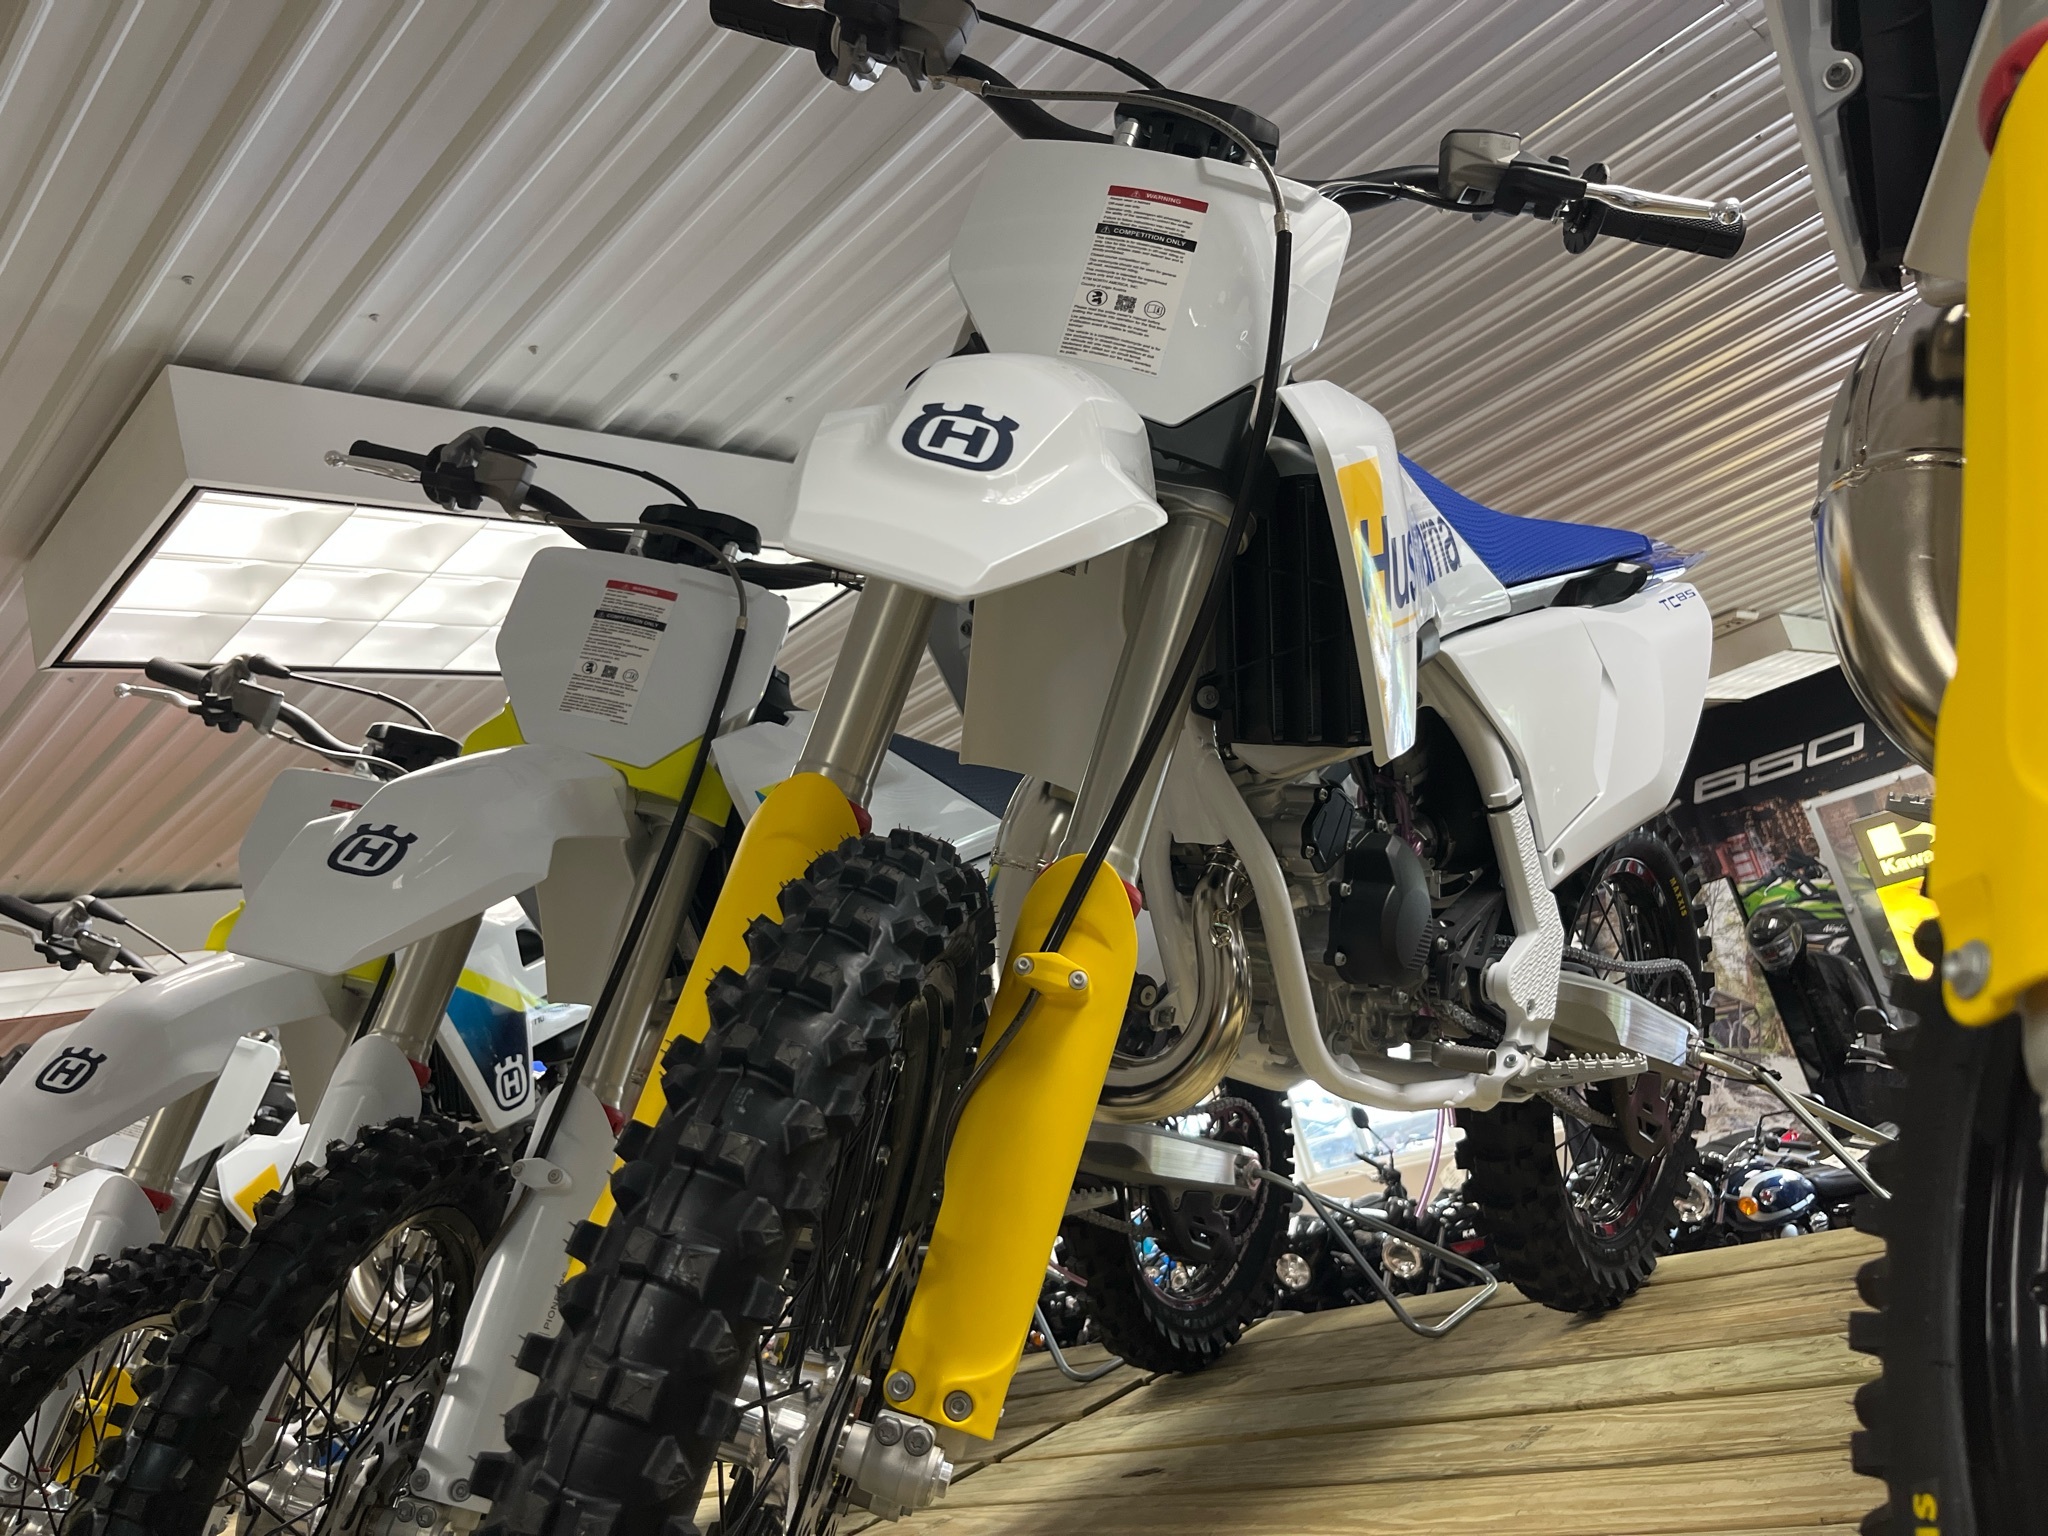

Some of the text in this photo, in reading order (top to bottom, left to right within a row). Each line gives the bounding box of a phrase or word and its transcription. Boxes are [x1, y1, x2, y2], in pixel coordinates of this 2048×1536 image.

[1146, 192, 1182, 205] WARNING
[1114, 228, 1186, 247] COMPETITION ONLY
[1658, 589, 1696, 610] TC85
[606, 614, 660, 628] COMPETITION ONLY
[1694, 722, 1865, 804] 650
[1668, 876, 1688, 918] MAXXIS
